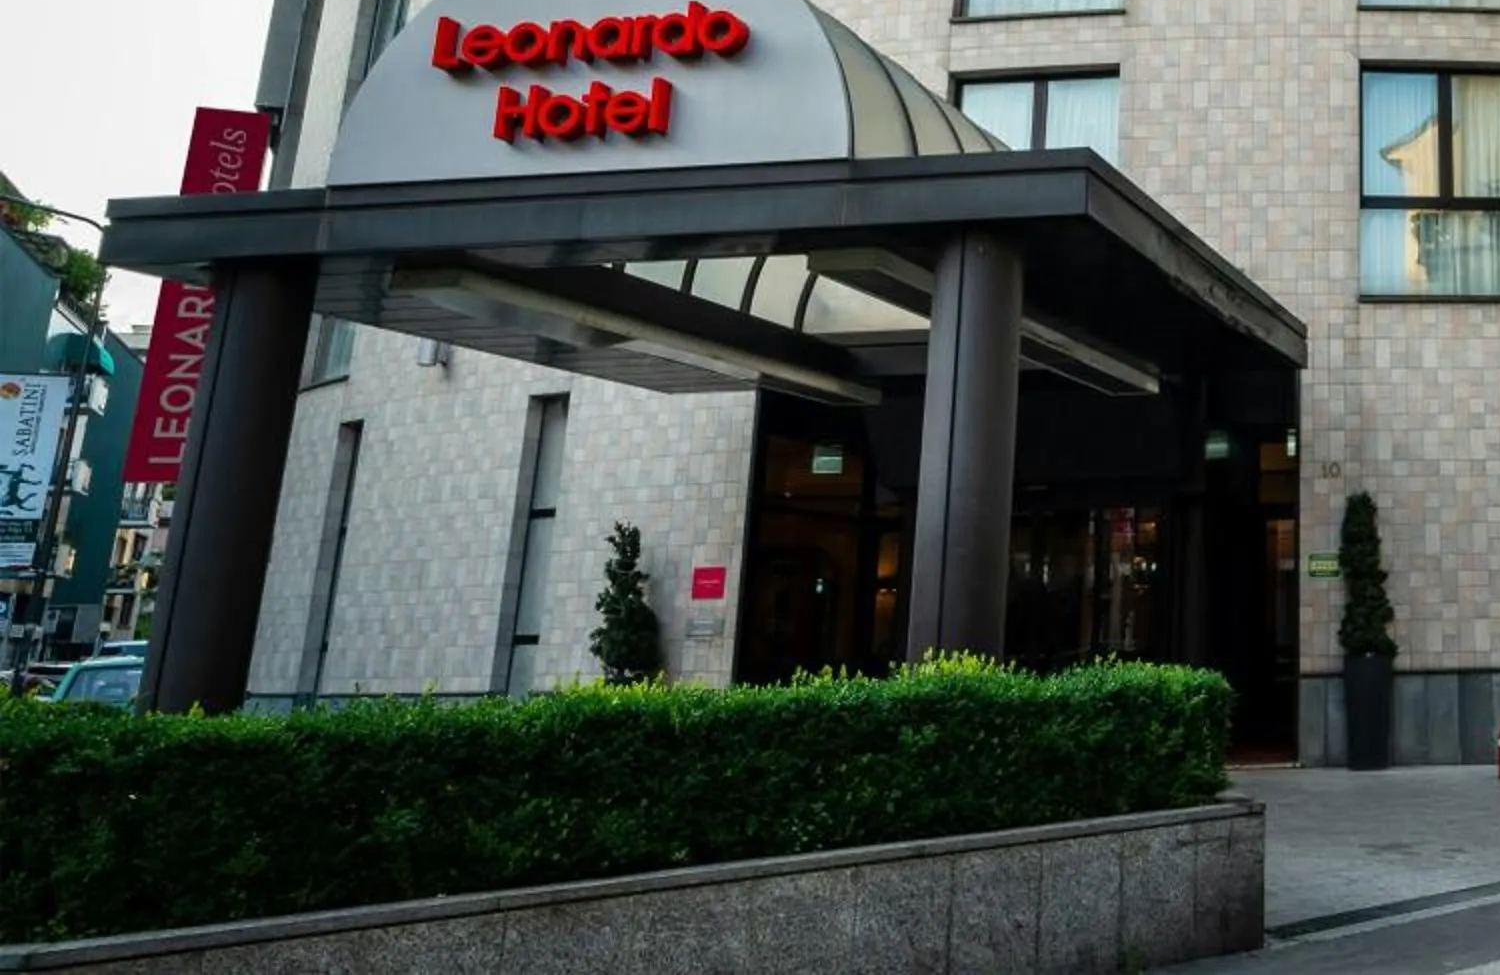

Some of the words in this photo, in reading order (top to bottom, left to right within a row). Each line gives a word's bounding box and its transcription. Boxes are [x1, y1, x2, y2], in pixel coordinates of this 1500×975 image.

[432, 0, 750, 75] Leonardo
[494, 76, 673, 145] Hotel
[148, 283, 216, 464] LEONAR
[208, 128, 247, 193] otels
[12, 384, 41, 456] SABATINI
